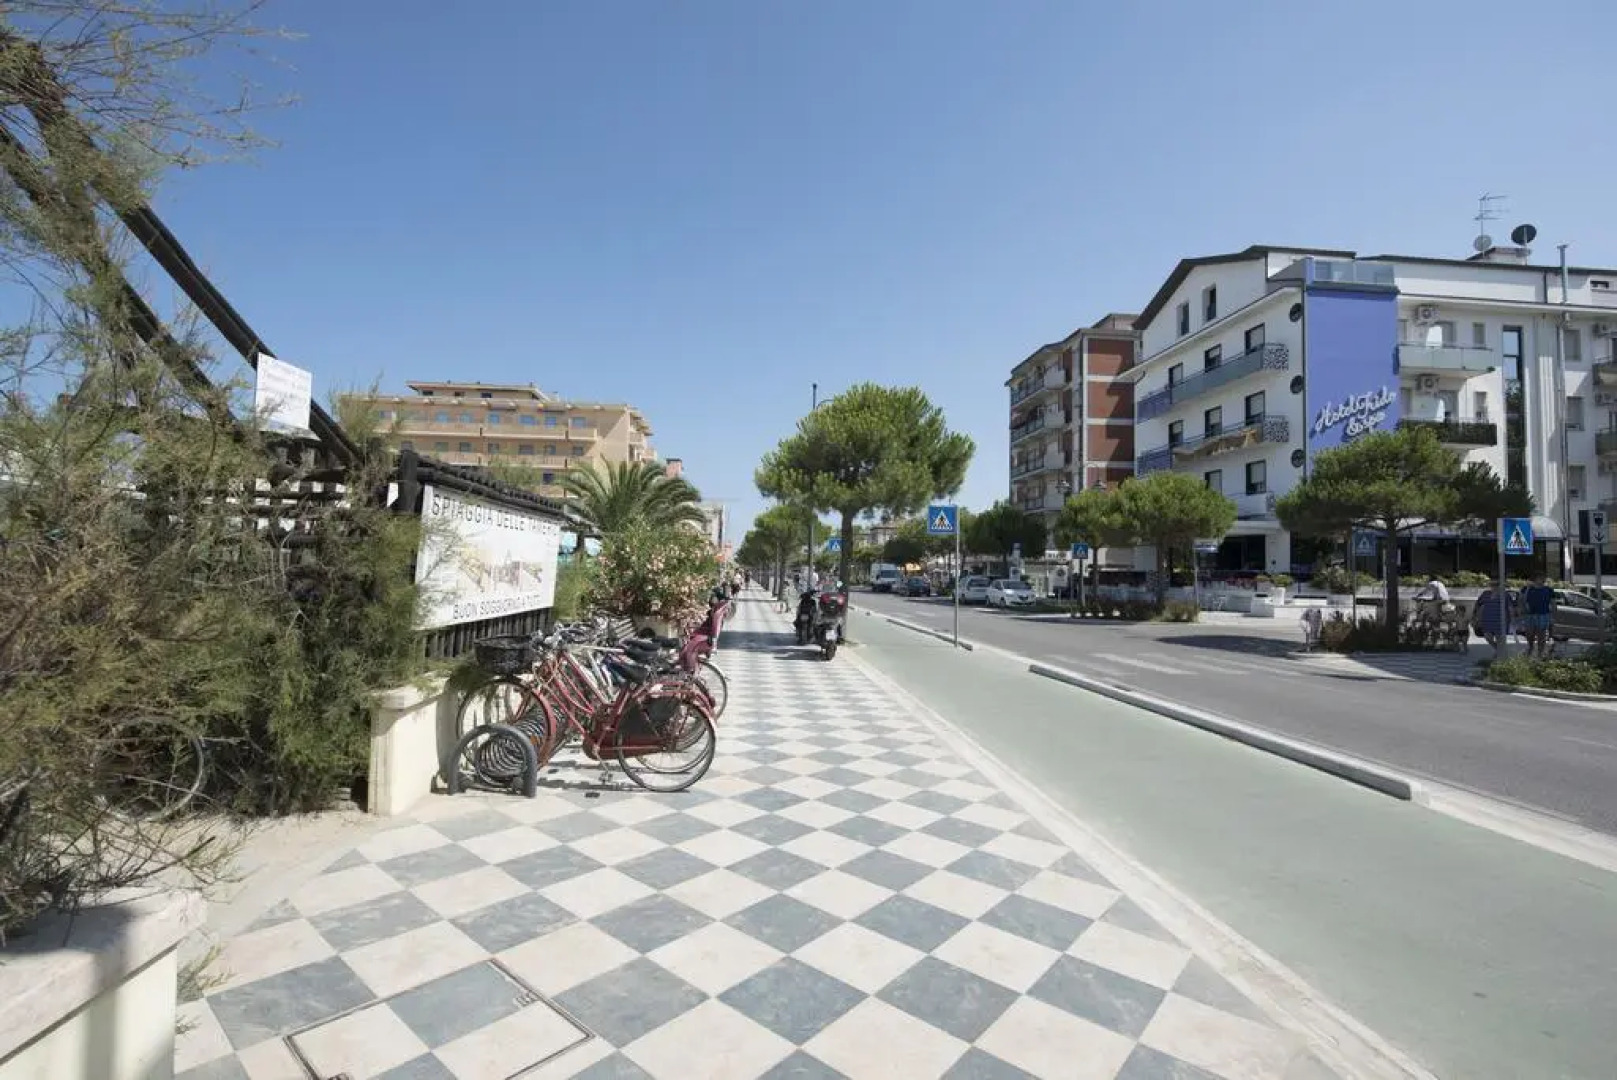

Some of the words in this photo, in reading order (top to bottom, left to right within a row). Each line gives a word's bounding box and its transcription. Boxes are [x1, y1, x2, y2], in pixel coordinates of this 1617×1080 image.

[1315, 394, 1357, 432] Hotel
[432, 493, 494, 526] SPIAGGIA
[497, 508, 525, 531] DELLE
[453, 601, 477, 620] BUON
